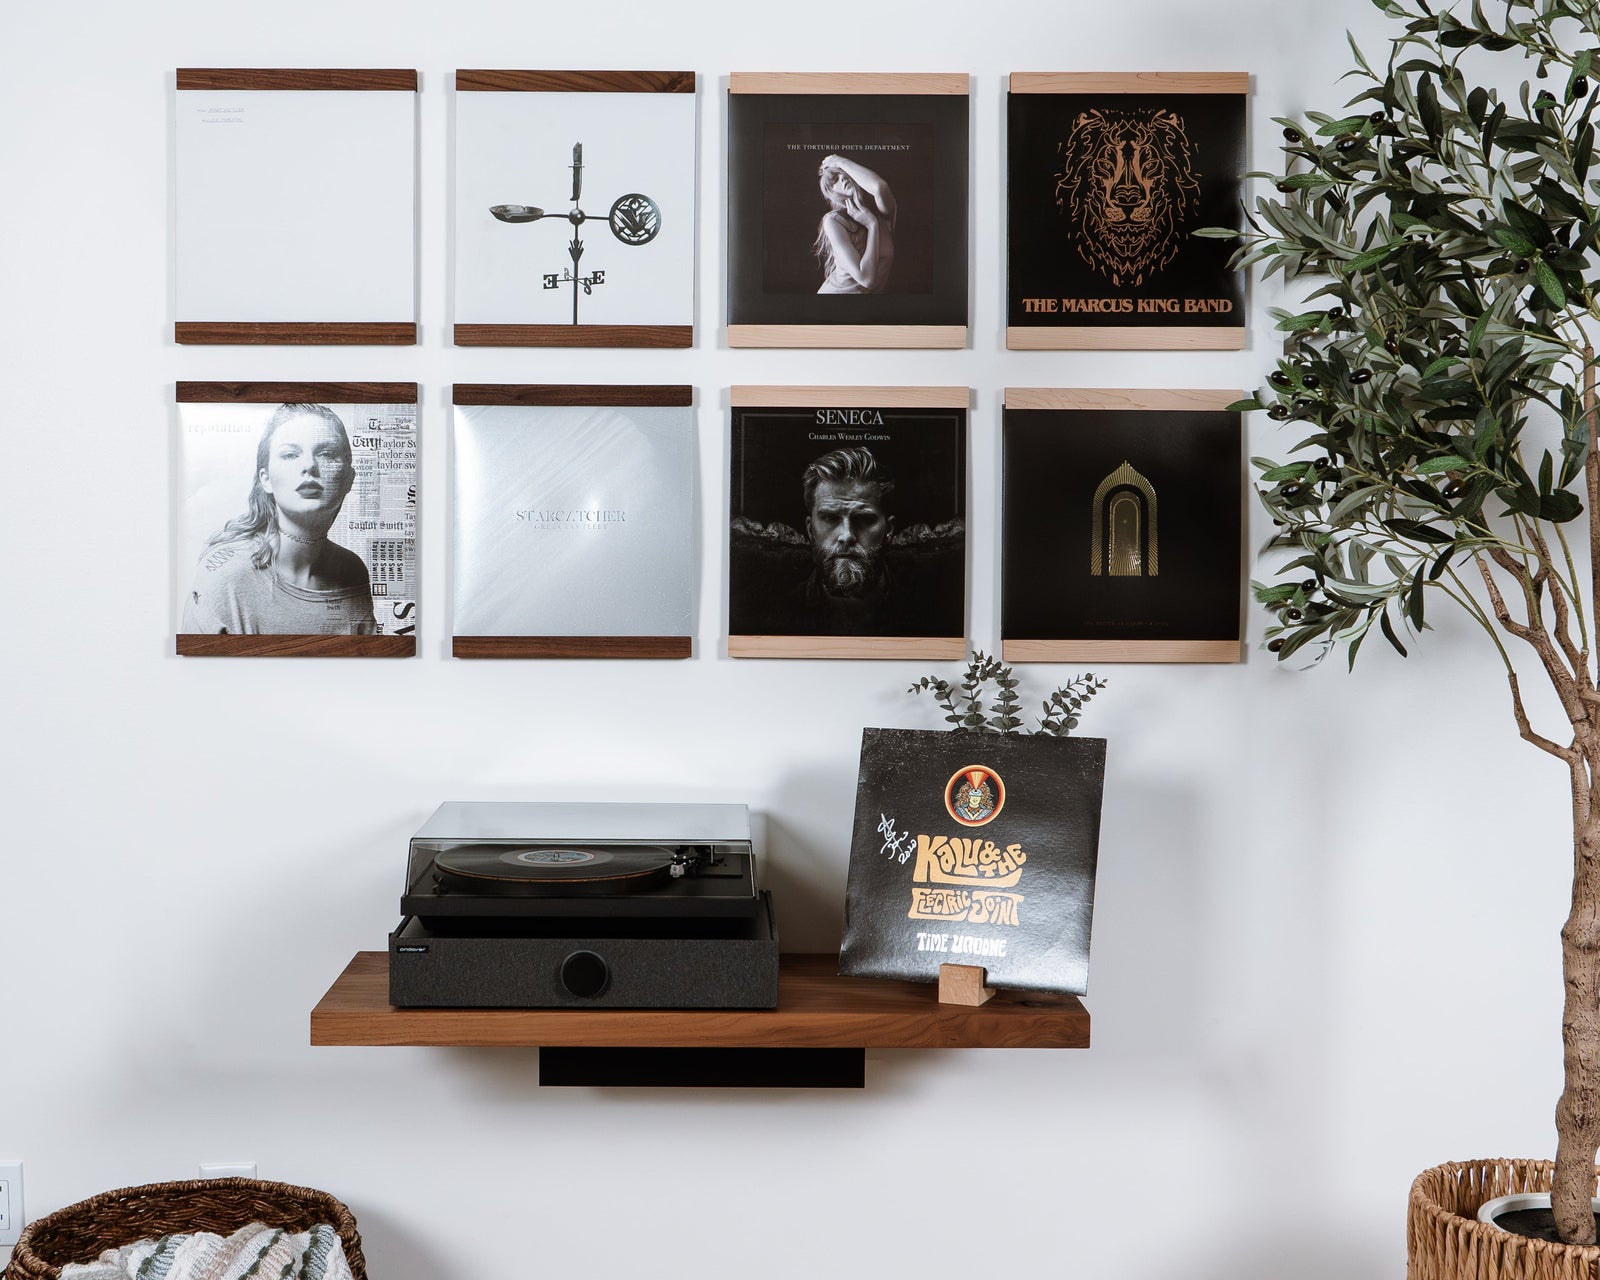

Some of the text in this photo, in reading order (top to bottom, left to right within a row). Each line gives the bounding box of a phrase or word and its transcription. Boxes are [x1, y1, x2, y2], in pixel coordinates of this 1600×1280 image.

[1022, 298, 1233, 313] THE MARCUS KING BAND
[816, 409, 884, 425] SENECA
[188, 423, 251, 436] reputation
[808, 432, 891, 441] CHARLES WESLEY GODWIN
[377, 450, 402, 461] taylor
[377, 461, 402, 471] taylor
[516, 510, 626, 522] STARCATCHER
[349, 521, 404, 531] Taylor Swift
[979, 841, 1001, 864] &
[978, 843, 1027, 877] THE
[951, 934, 1008, 957] UNDONE
